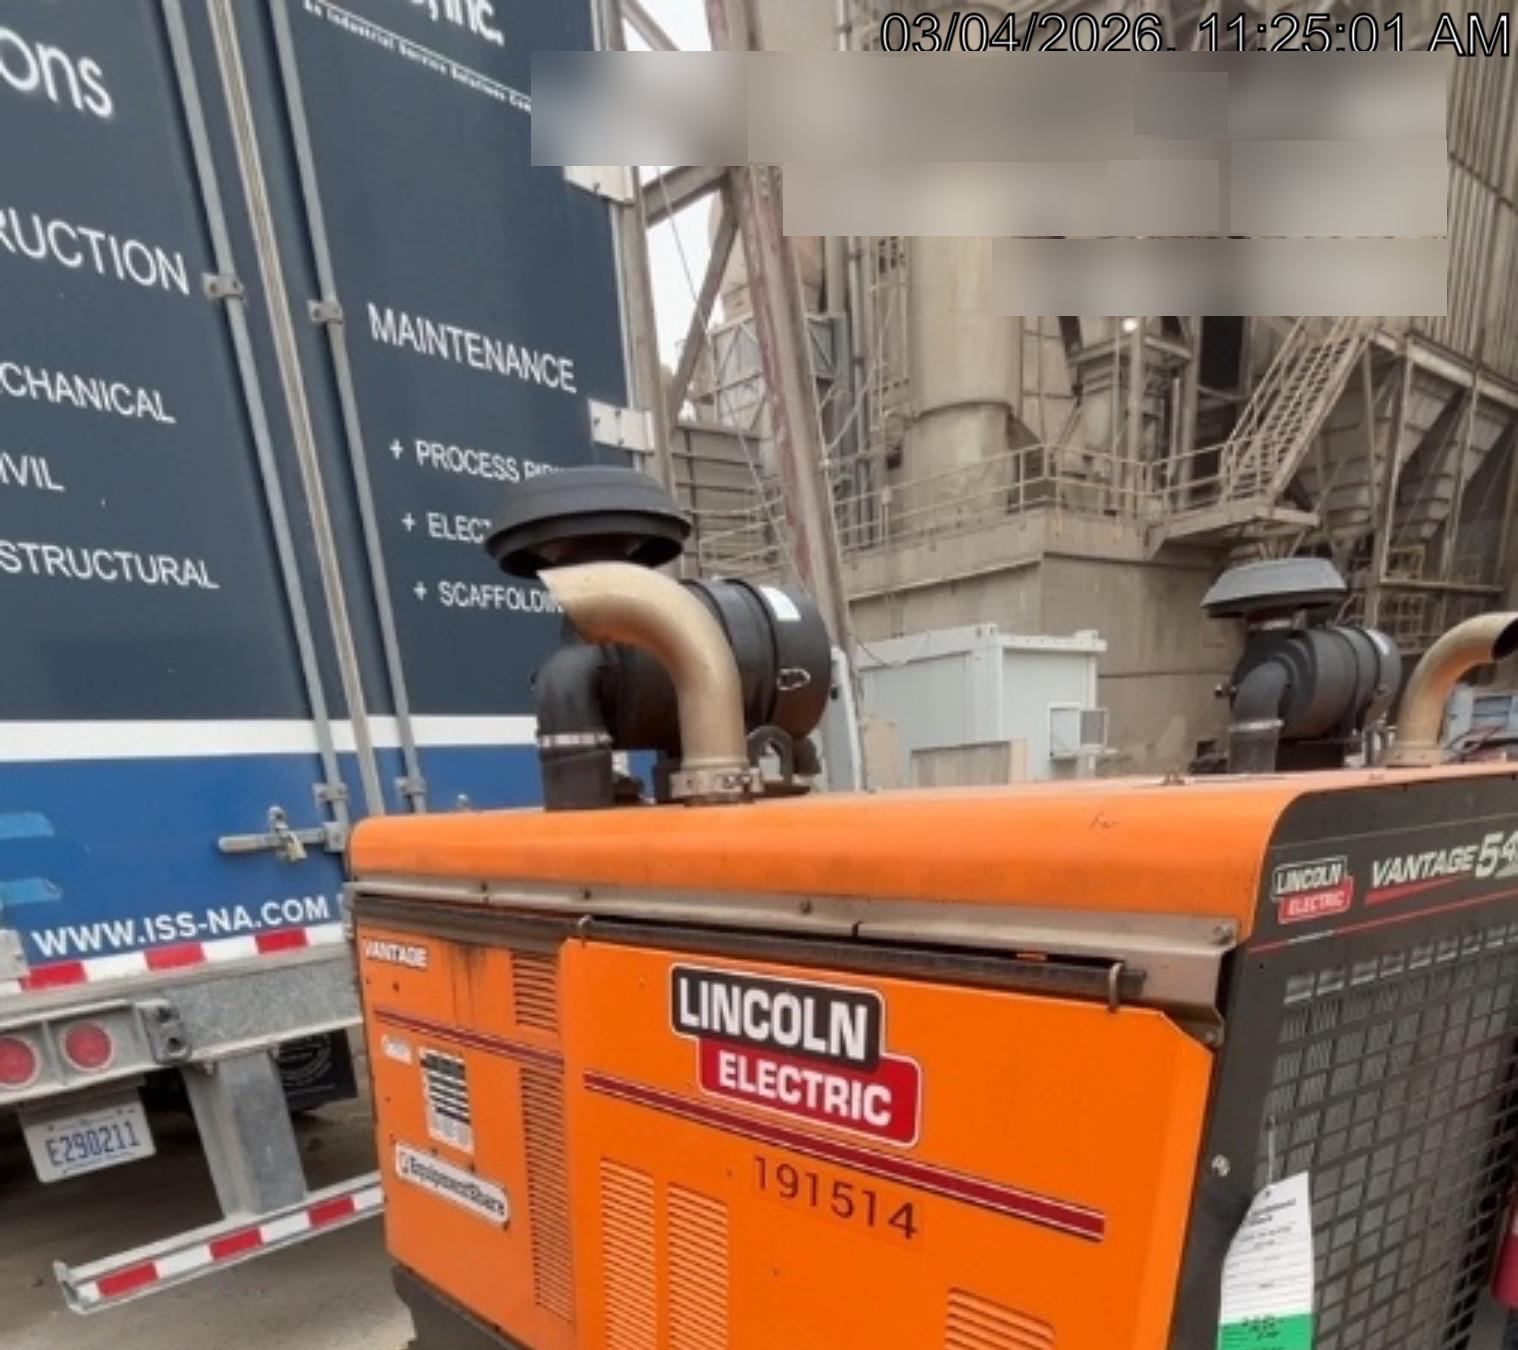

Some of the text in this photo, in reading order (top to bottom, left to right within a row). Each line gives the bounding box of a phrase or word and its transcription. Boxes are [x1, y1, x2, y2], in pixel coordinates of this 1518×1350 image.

[368, 302, 577, 395] MAINTENANCE
[415, 439, 520, 484] PROCESS
[1277, 863, 1343, 894] LINCOLN
[1372, 845, 1478, 888] VANTAGE
[32, 895, 330, 960] WWW.ISS-NA.COM
[679, 976, 869, 1062] LINCOLN
[718, 1049, 892, 1127] ELECTRIC
[753, 1155, 918, 1241] 191514
